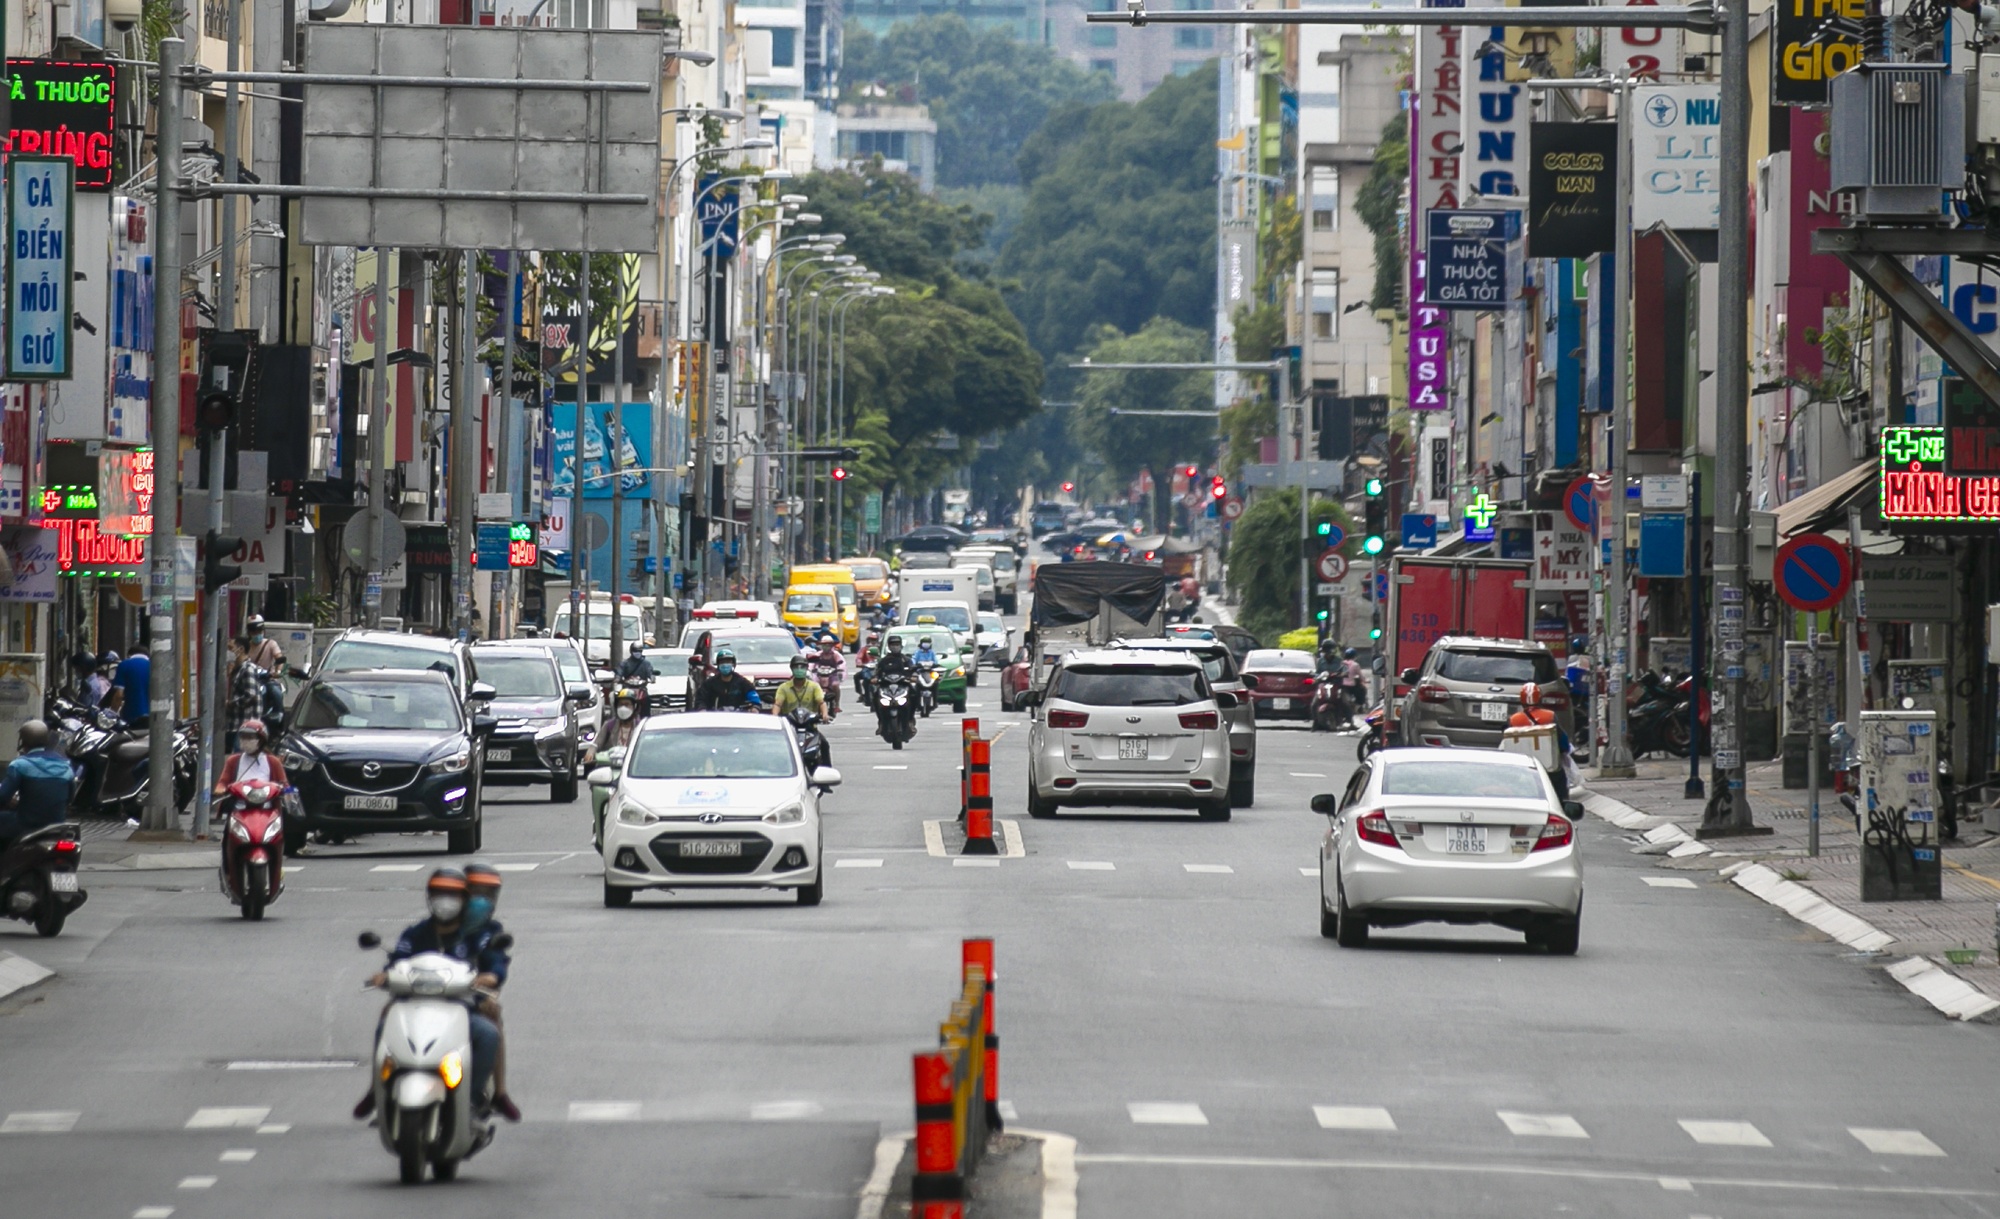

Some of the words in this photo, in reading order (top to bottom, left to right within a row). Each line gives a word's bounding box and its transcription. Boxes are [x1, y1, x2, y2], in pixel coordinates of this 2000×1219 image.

[36, 74, 111, 103] THUỐC
[1544, 152, 1604, 171] COLOR
[27, 171, 53, 207] CÁ
[1557, 175, 1595, 193] MAN
[17, 218, 62, 259] BIỂN
[1442, 260, 1498, 280] THUỐC
[20, 271, 57, 312] MỖI
[1440, 282, 1467, 301] GIÁ
[1470, 280, 1500, 301] TỐT
[22, 327, 55, 364] GIỜ
[1456, 827, 1478, 839] 51A
